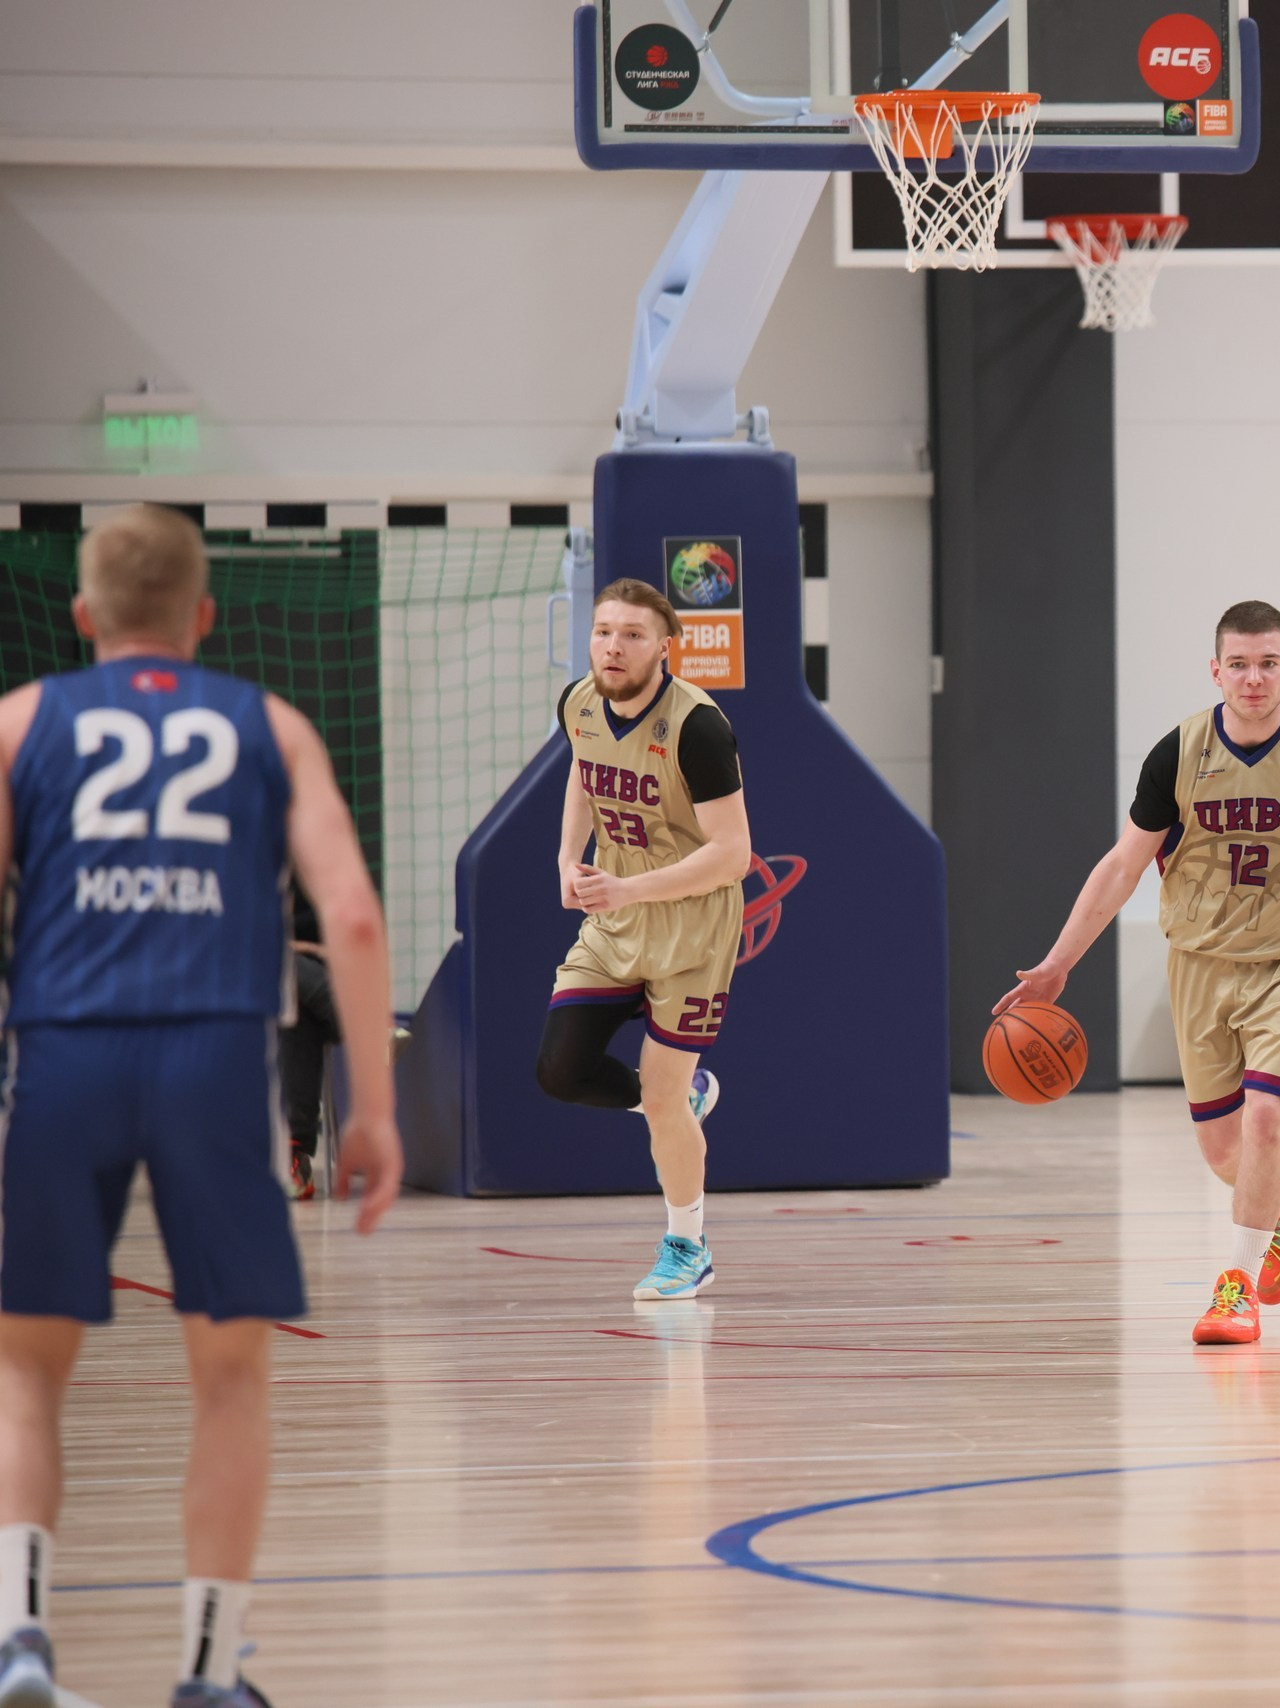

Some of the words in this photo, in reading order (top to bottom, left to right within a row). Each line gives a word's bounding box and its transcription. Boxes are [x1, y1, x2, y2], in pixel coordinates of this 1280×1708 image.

[625, 70, 690, 79] СТУДЕНЧЕСКАЯ
[1149, 47, 1212, 75] АСБ
[637, 80, 659, 88] ЛИГА
[1204, 104, 1227, 117] FIBA
[680, 623, 731, 650] FIBA
[680, 667, 731, 678] EQUIPMENT
[682, 655, 730, 666] APPROVED
[71, 707, 238, 843] 22
[578, 758, 660, 806] ЦИВС
[598, 806, 649, 849] 23
[1228, 843, 1270, 887] 12
[74, 866, 224, 916] МОСКВА
[677, 992, 729, 1033] 23
